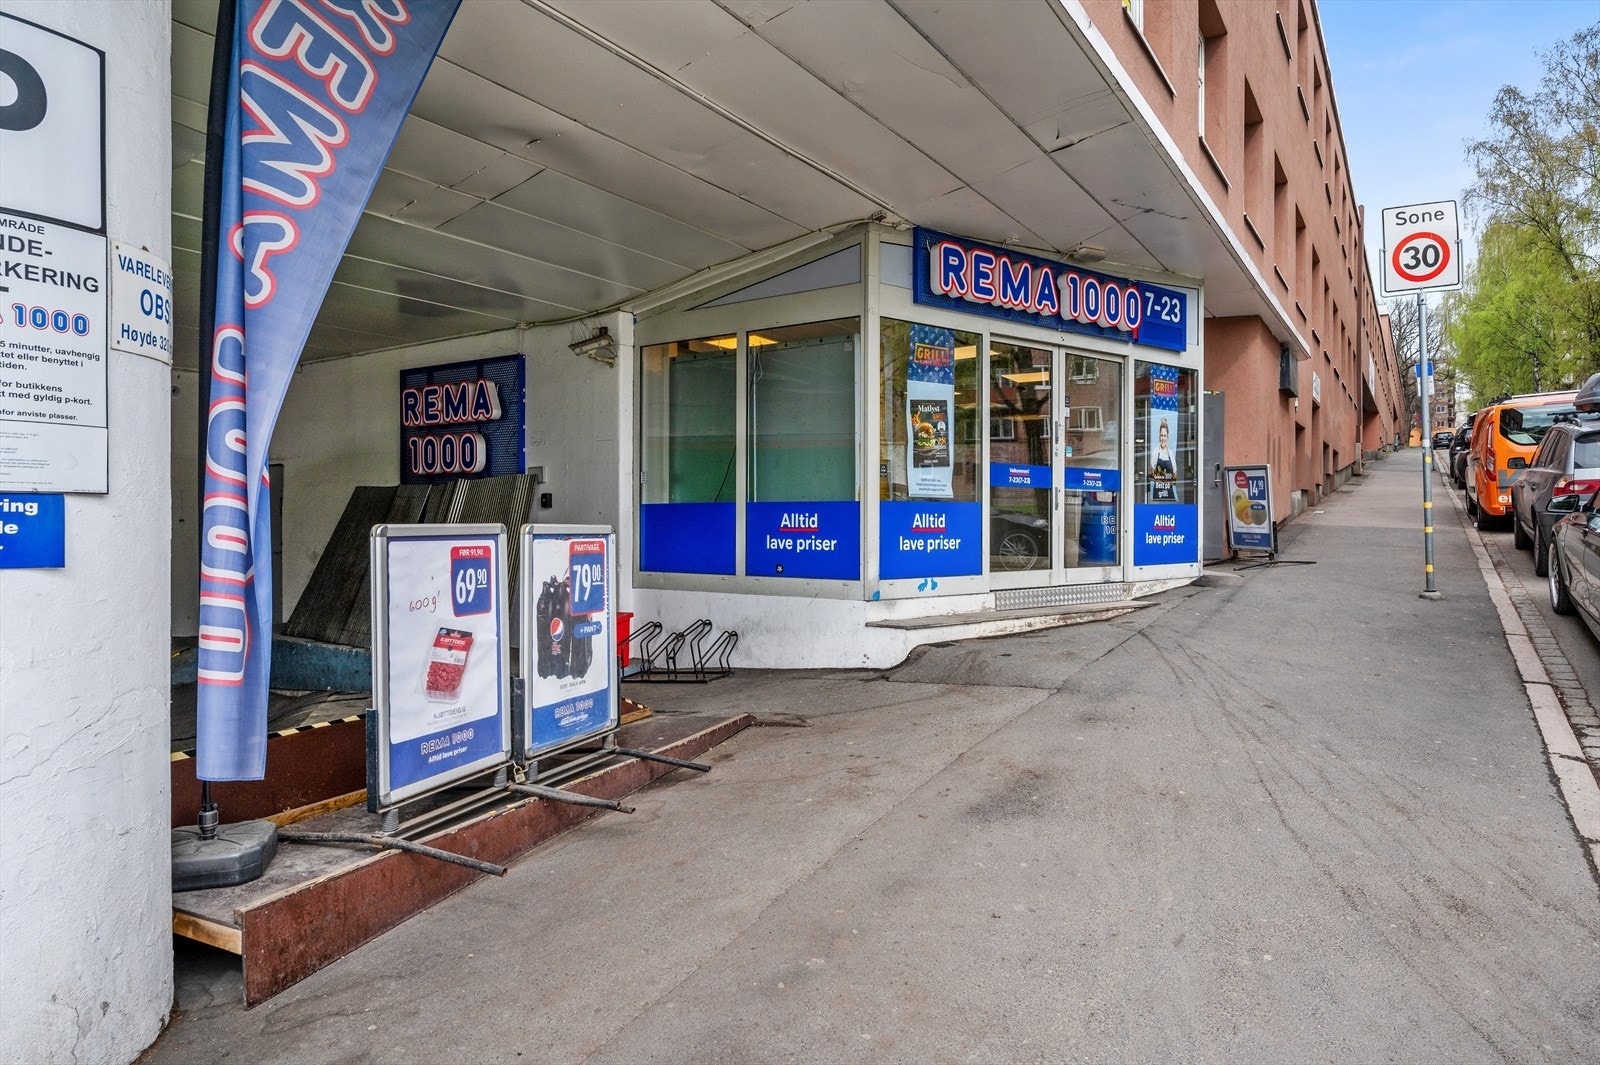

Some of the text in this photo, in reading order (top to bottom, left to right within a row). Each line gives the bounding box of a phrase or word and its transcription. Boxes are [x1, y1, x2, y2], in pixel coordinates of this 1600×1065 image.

[1395, 210, 1445, 226] Sone
[1403, 244, 1440, 270] 30
[0, 259, 99, 293] KERING
[118, 254, 173, 294] VARELEVE
[939, 240, 1181, 329] REMA 1000 7-23
[11, 303, 90, 337] 1000
[121, 323, 157, 347] Høyde
[17, 353, 39, 361] eller
[41, 355, 79, 367] benyttet
[55, 348, 100, 361] uavhengig
[16, 381, 63, 392] butikkens
[9, 391, 31, 399] med
[33, 393, 62, 403] gyldig
[64, 397, 93, 406] p-kort.
[402, 377, 493, 427] REMA
[16, 410, 47, 418] anviste
[48, 412, 78, 421] plasser.
[918, 405, 941, 414] Matlyst
[409, 432, 478, 475] 1000
[0, 498, 39, 516] ing
[780, 513, 818, 528] Alltid
[912, 513, 946, 528] Alltid
[1154, 515, 1175, 527] Alltid
[766, 535, 837, 552] lave priser
[899, 535, 961, 552] lave priser
[1146, 532, 1185, 546] lave priser
[409, 597, 430, 612] 600
[420, 727, 475, 756] REMA 1000
